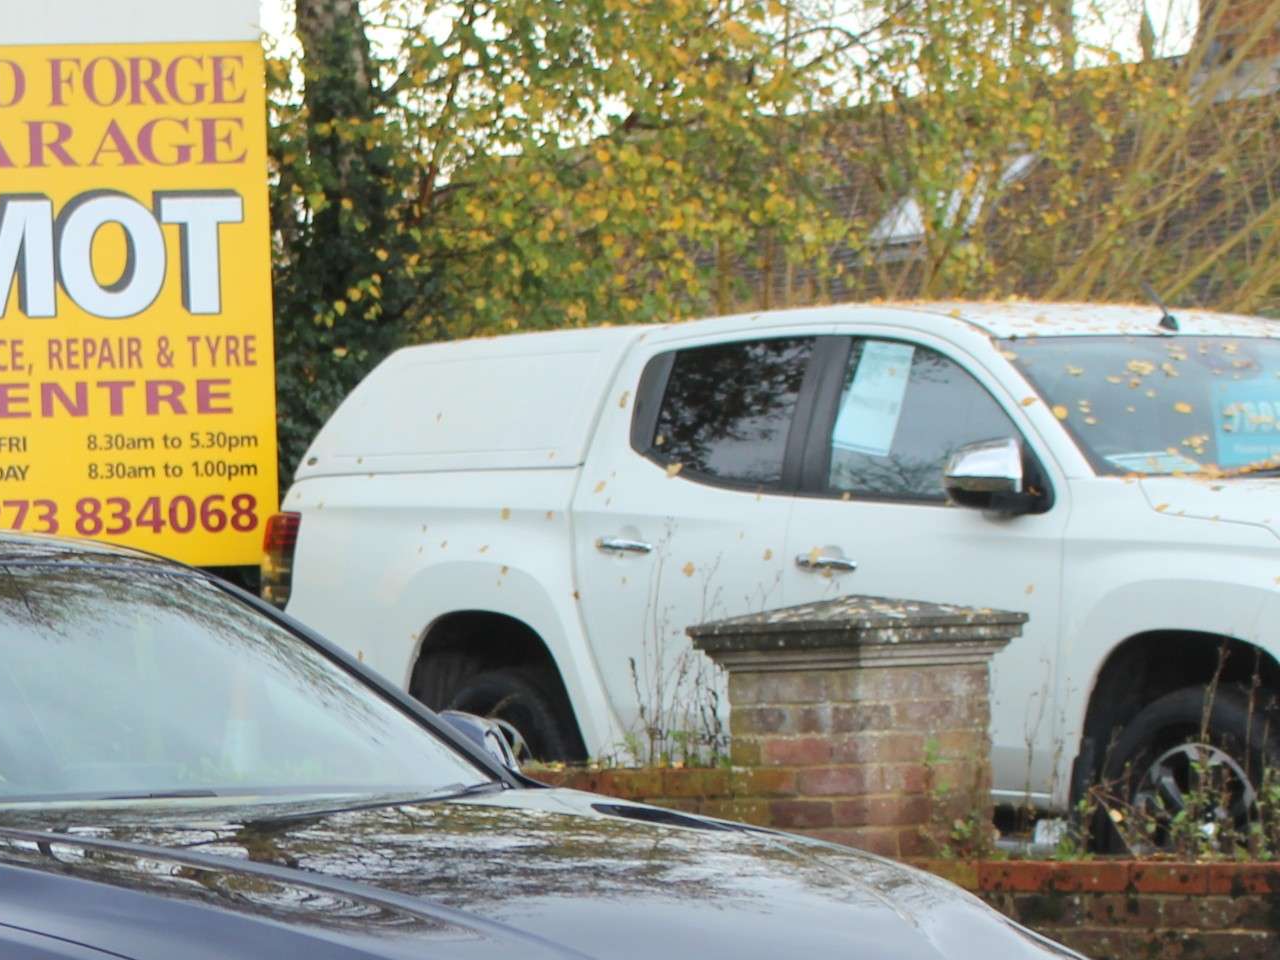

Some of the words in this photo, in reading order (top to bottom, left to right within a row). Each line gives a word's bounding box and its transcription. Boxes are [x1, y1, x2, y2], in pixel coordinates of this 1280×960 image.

[47, 55, 248, 107] FORGE
[47, 337, 144, 371] REPAIR
[156, 336, 175, 368] &
[187, 335, 258, 367] TYRE
[87, 434, 155, 451] 8.30am
[162, 434, 182, 450] to
[190, 433, 259, 451] 5.30pm
[88, 463, 156, 480] 8.30am
[163, 462, 184, 479] to
[192, 461, 259, 481] 1.00pm
[74, 494, 259, 537] 834068
